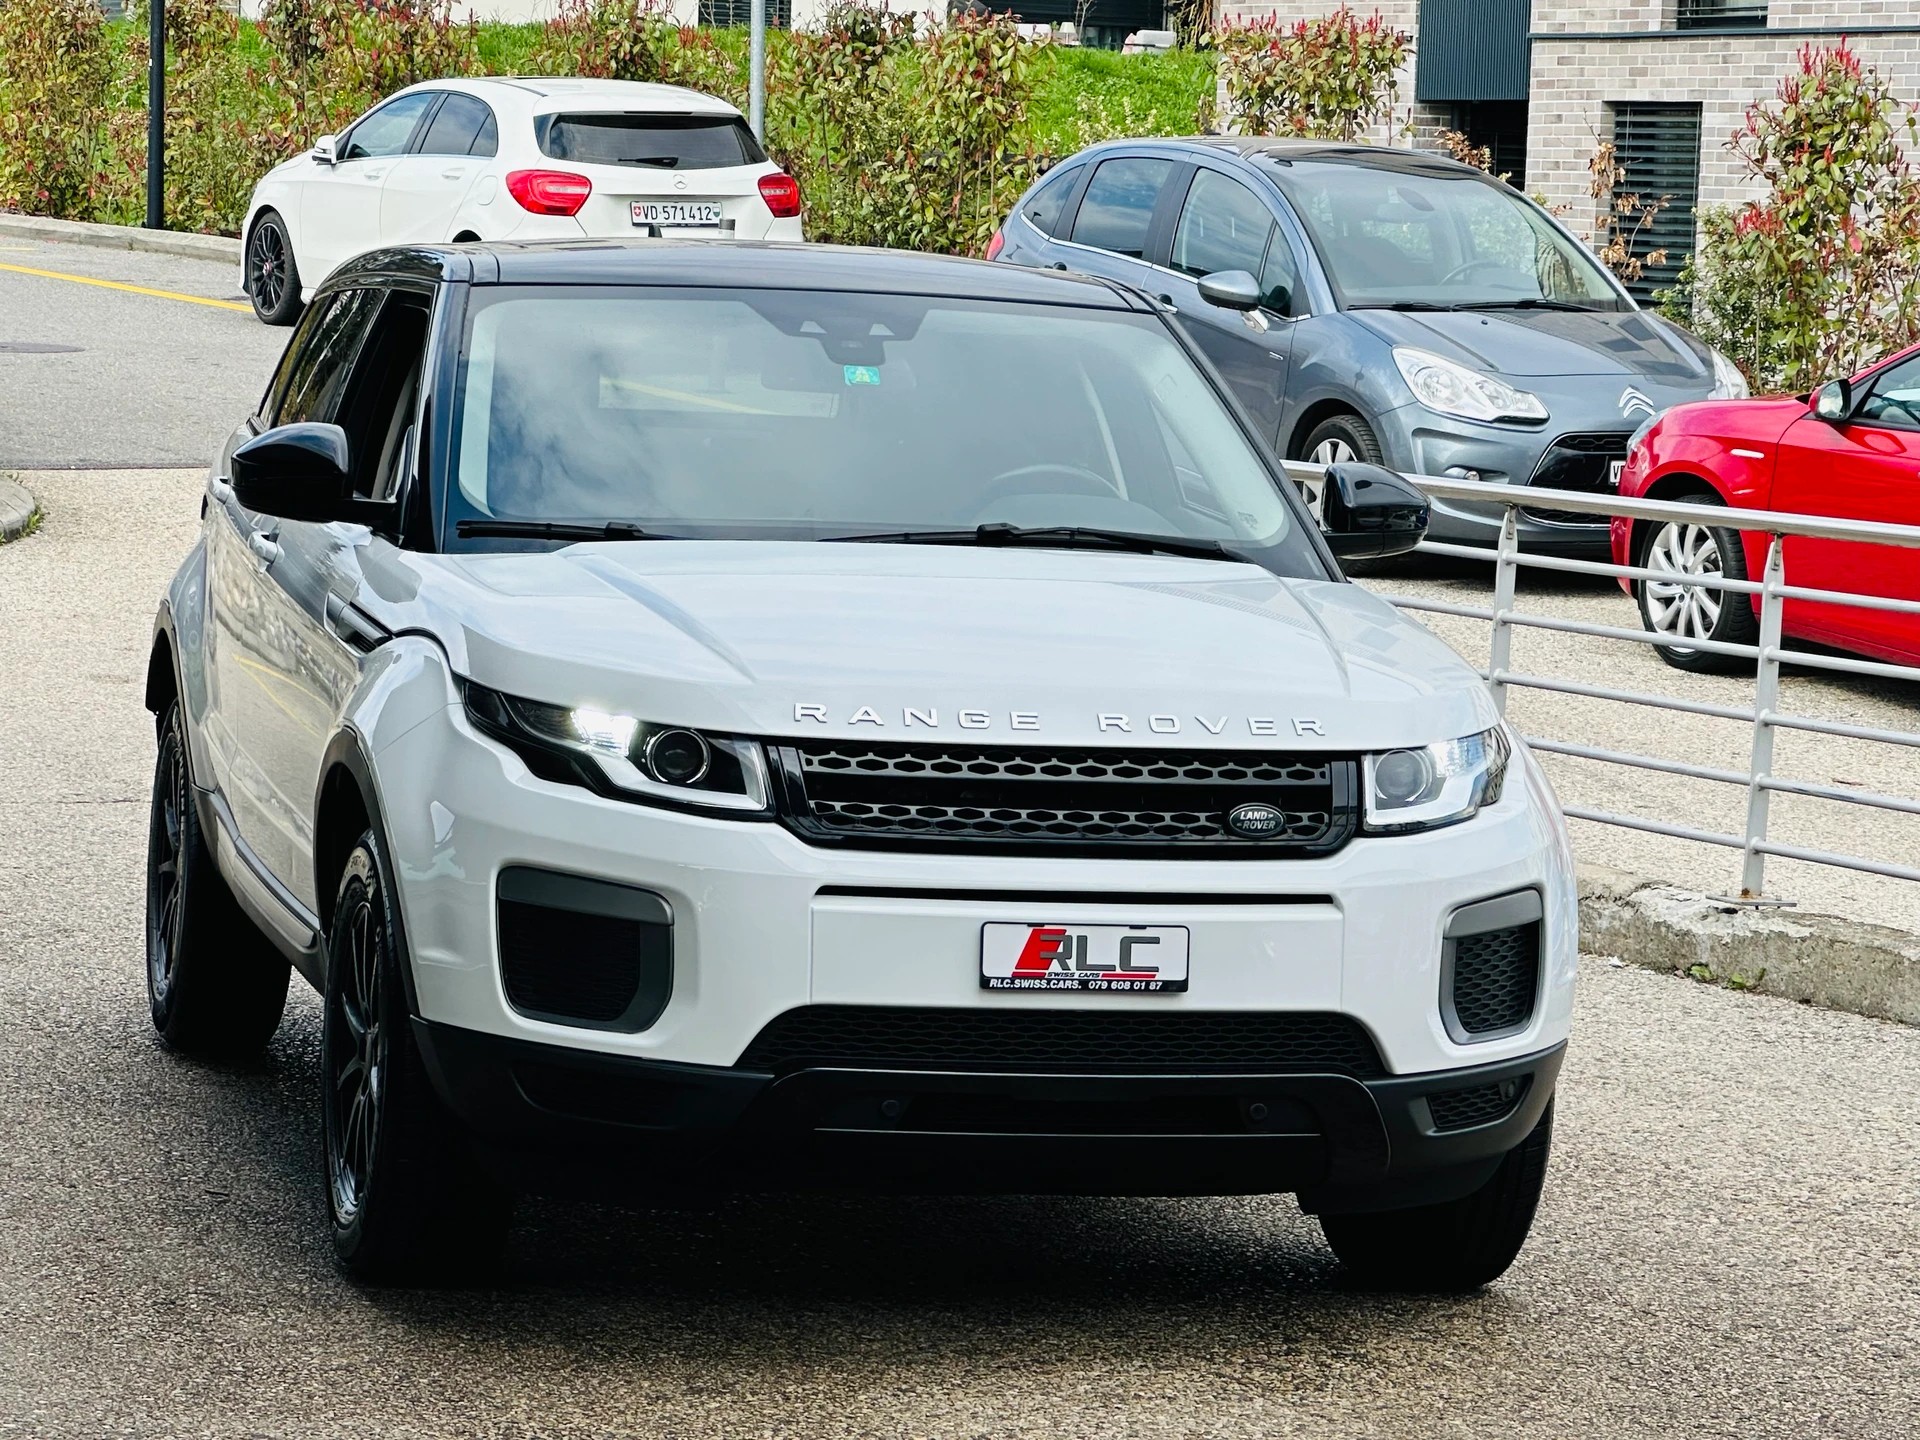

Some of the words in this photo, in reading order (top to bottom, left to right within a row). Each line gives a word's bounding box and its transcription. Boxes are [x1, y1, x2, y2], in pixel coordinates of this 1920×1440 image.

[793, 702, 1041, 731] RANGE
[1096, 712, 1326, 737] ROVER
[1240, 811, 1268, 820] LAND
[1242, 820, 1276, 830] ROVER
[1039, 934, 1161, 973] RLC
[1088, 980, 1108, 990] 079
[1111, 981, 1131, 991] 608
[1133, 981, 1146, 991] 01
[1149, 981, 1163, 991] 87
